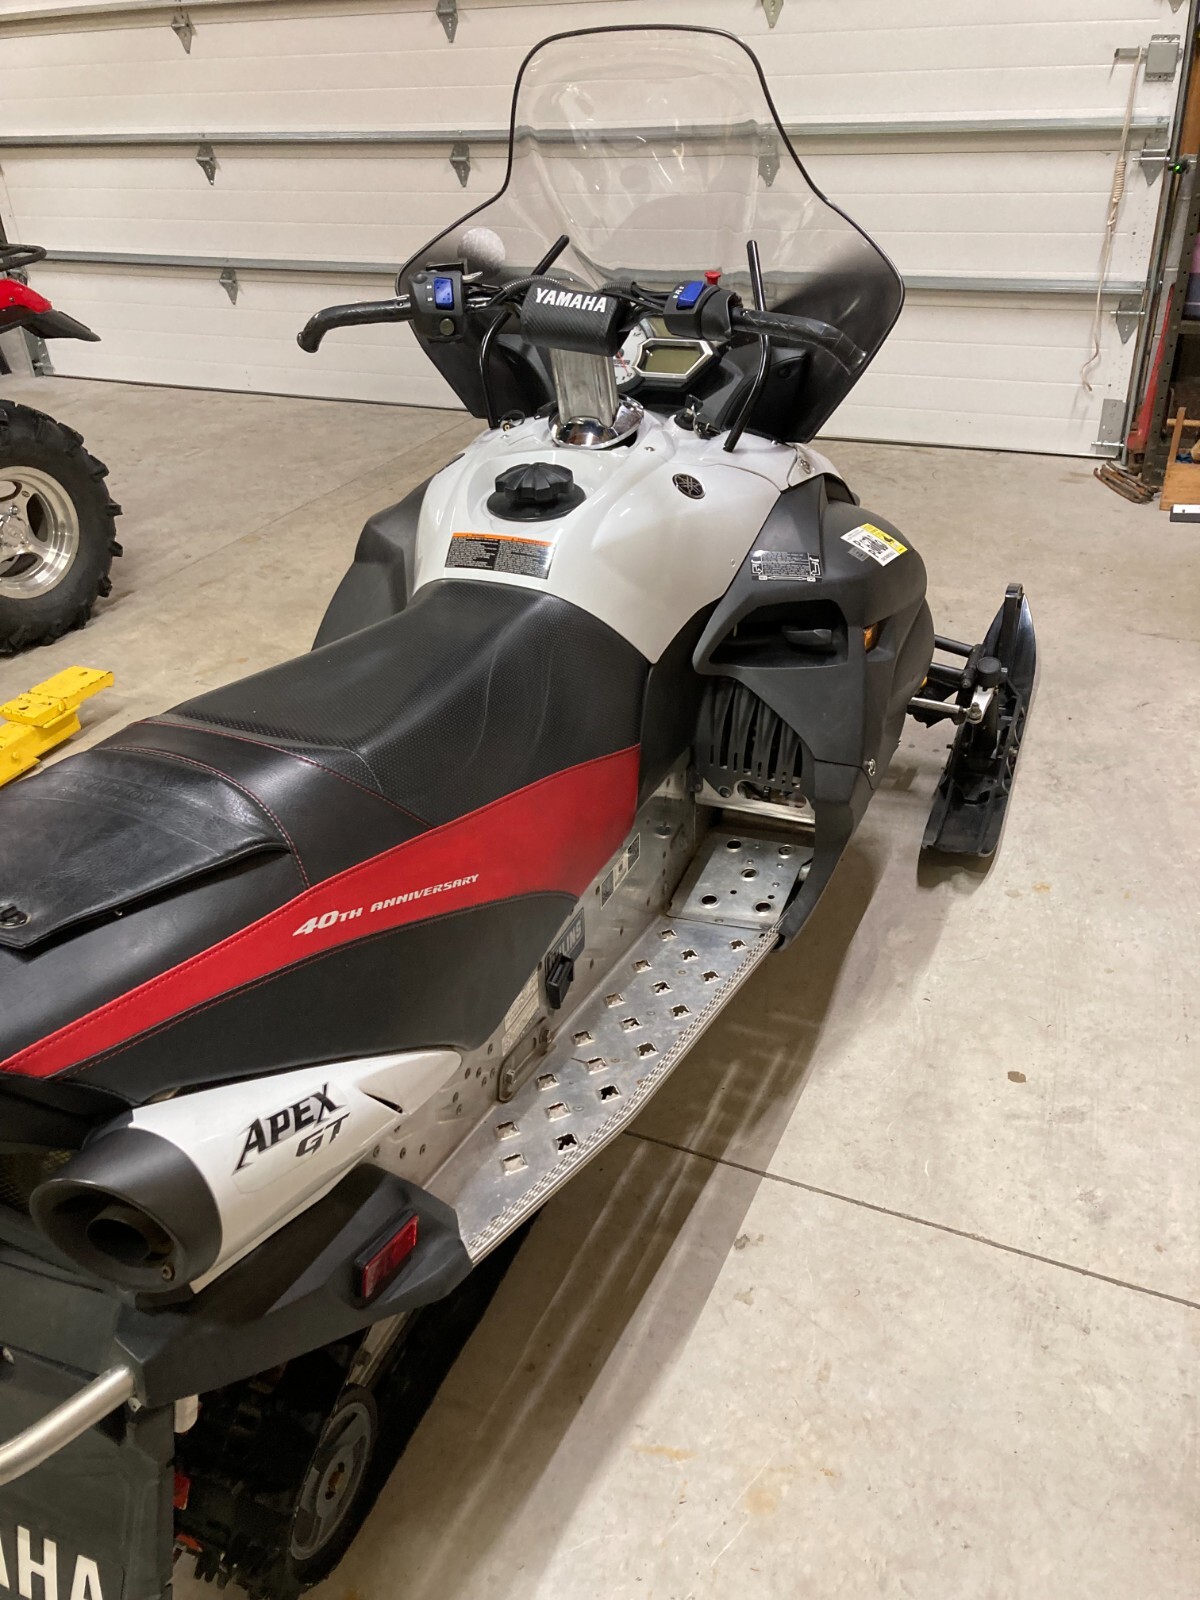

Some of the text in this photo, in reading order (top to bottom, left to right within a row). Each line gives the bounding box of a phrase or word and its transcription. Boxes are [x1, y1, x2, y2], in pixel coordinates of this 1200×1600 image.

[535, 287, 608, 313] YAMAHA
[292, 873, 480, 937] 40TH ANNIVERSARY
[232, 1082, 341, 1173] APEX
[295, 1111, 351, 1157] GT
